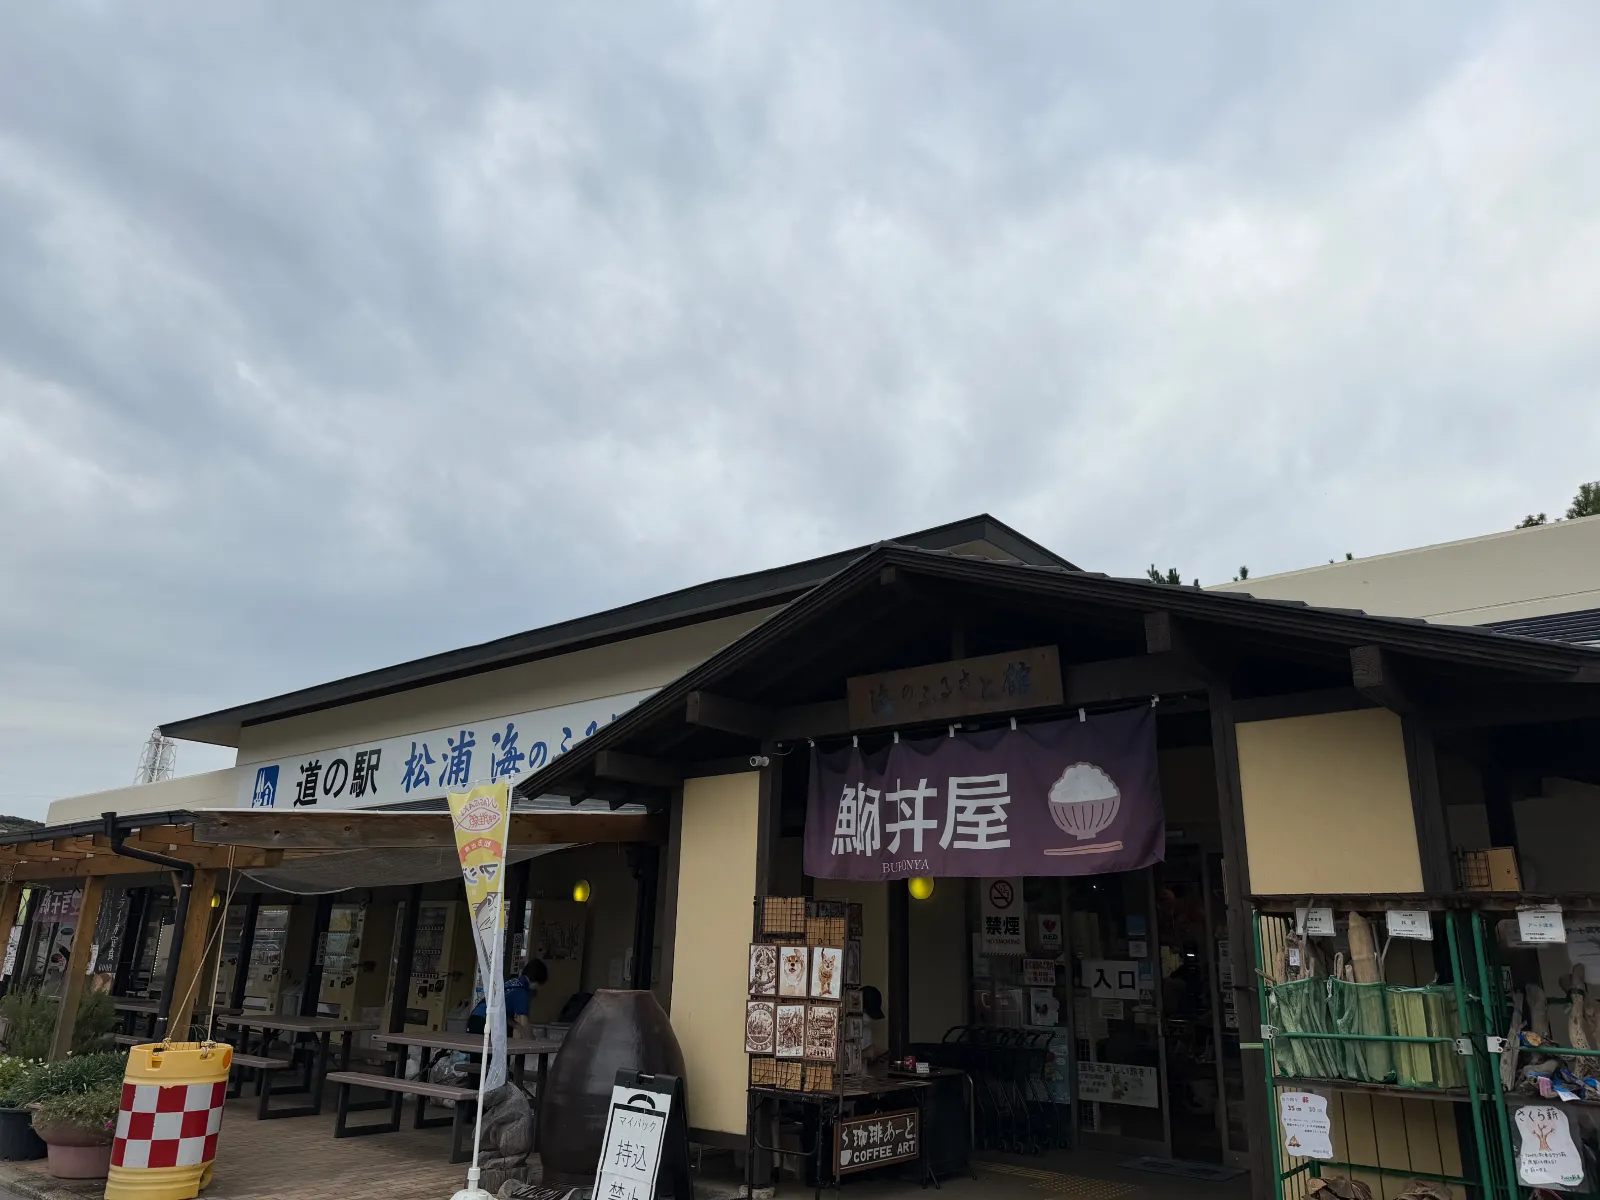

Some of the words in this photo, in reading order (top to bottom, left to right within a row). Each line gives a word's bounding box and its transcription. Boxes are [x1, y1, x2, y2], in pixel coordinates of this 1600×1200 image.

[293, 747, 382, 808] 道の駅
[400, 730, 476, 794] 松浦
[830, 772, 1012, 858] 鰤丼屋
[985, 915, 1020, 936] 禁煙
[1043, 933, 1058, 941] AED
[1093, 968, 1136, 991] 入口
[1077, 1062, 1152, 1078] 運転で楽しい旅を！
[1517, 1107, 1559, 1122] さくら薪
[614, 1138, 647, 1172] 持込
[853, 1144, 893, 1163] COFFEE
[897, 1140, 916, 1155] ART
